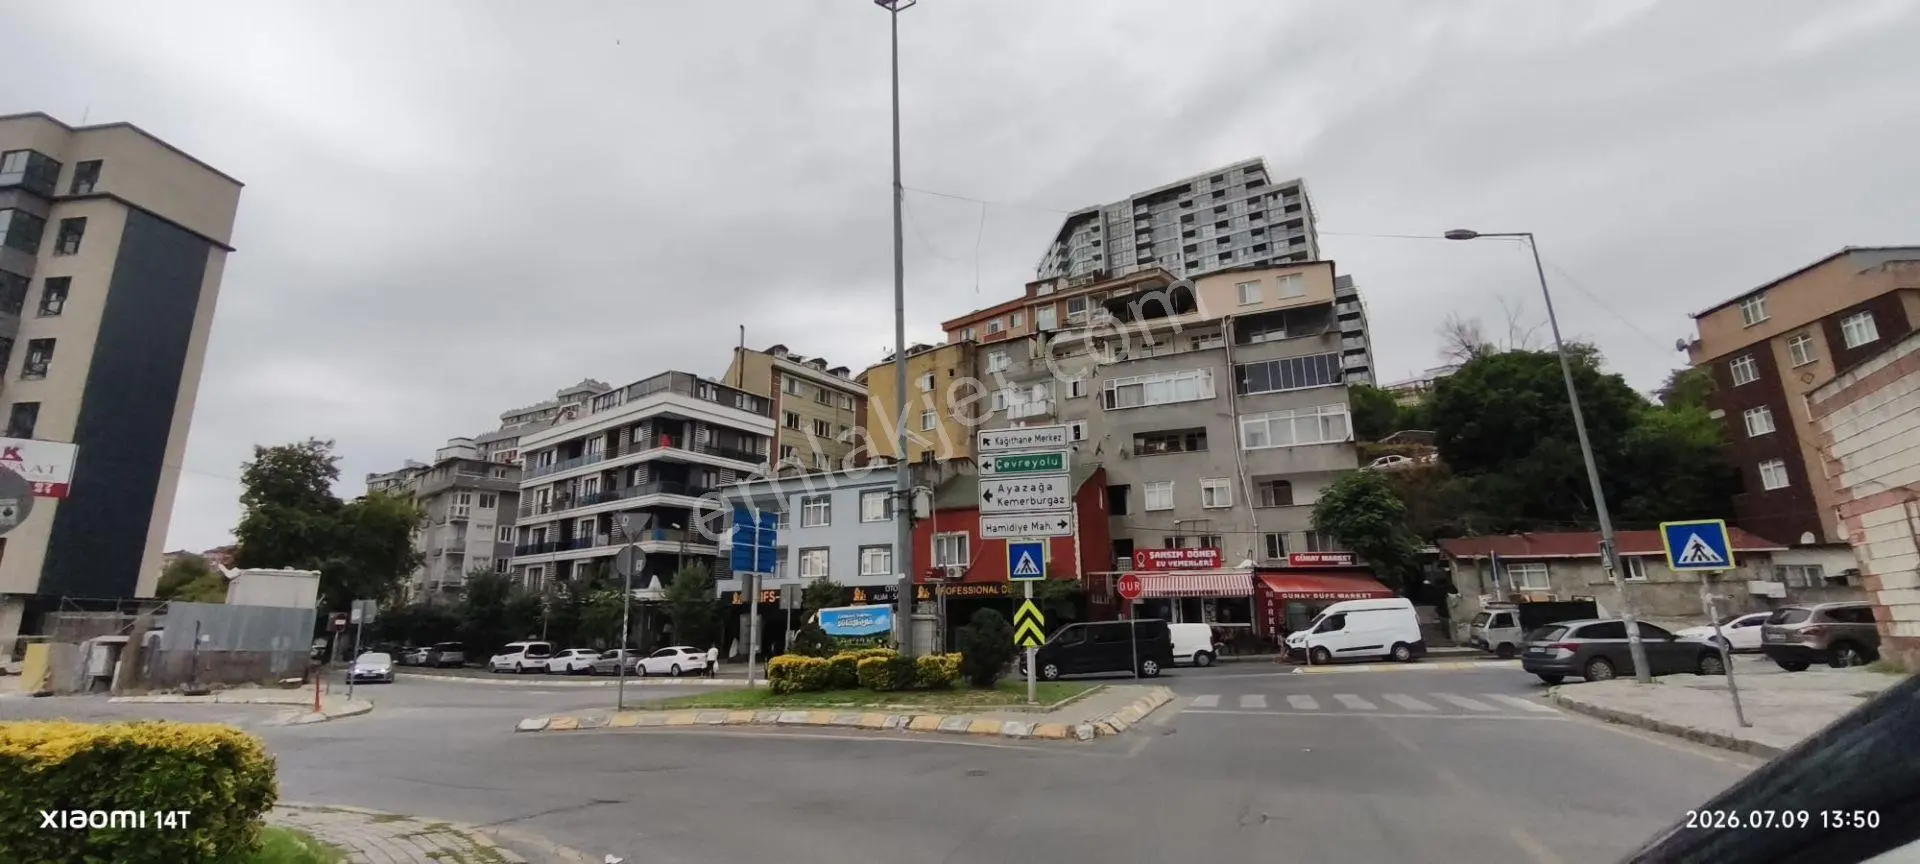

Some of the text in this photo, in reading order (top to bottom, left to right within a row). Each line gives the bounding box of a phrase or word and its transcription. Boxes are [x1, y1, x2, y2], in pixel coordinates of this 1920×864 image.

[994, 433, 1062, 447] Kağıthane Merkez
[995, 456, 1058, 470] Çevreyolu
[997, 482, 1053, 494] Ayazağa
[997, 496, 1065, 508] Kemerburgaz
[985, 521, 1053, 534] Hamidiye Mah.
[935, 585, 999, 596] PROFESSIONAL
[1120, 581, 1140, 592] DUR
